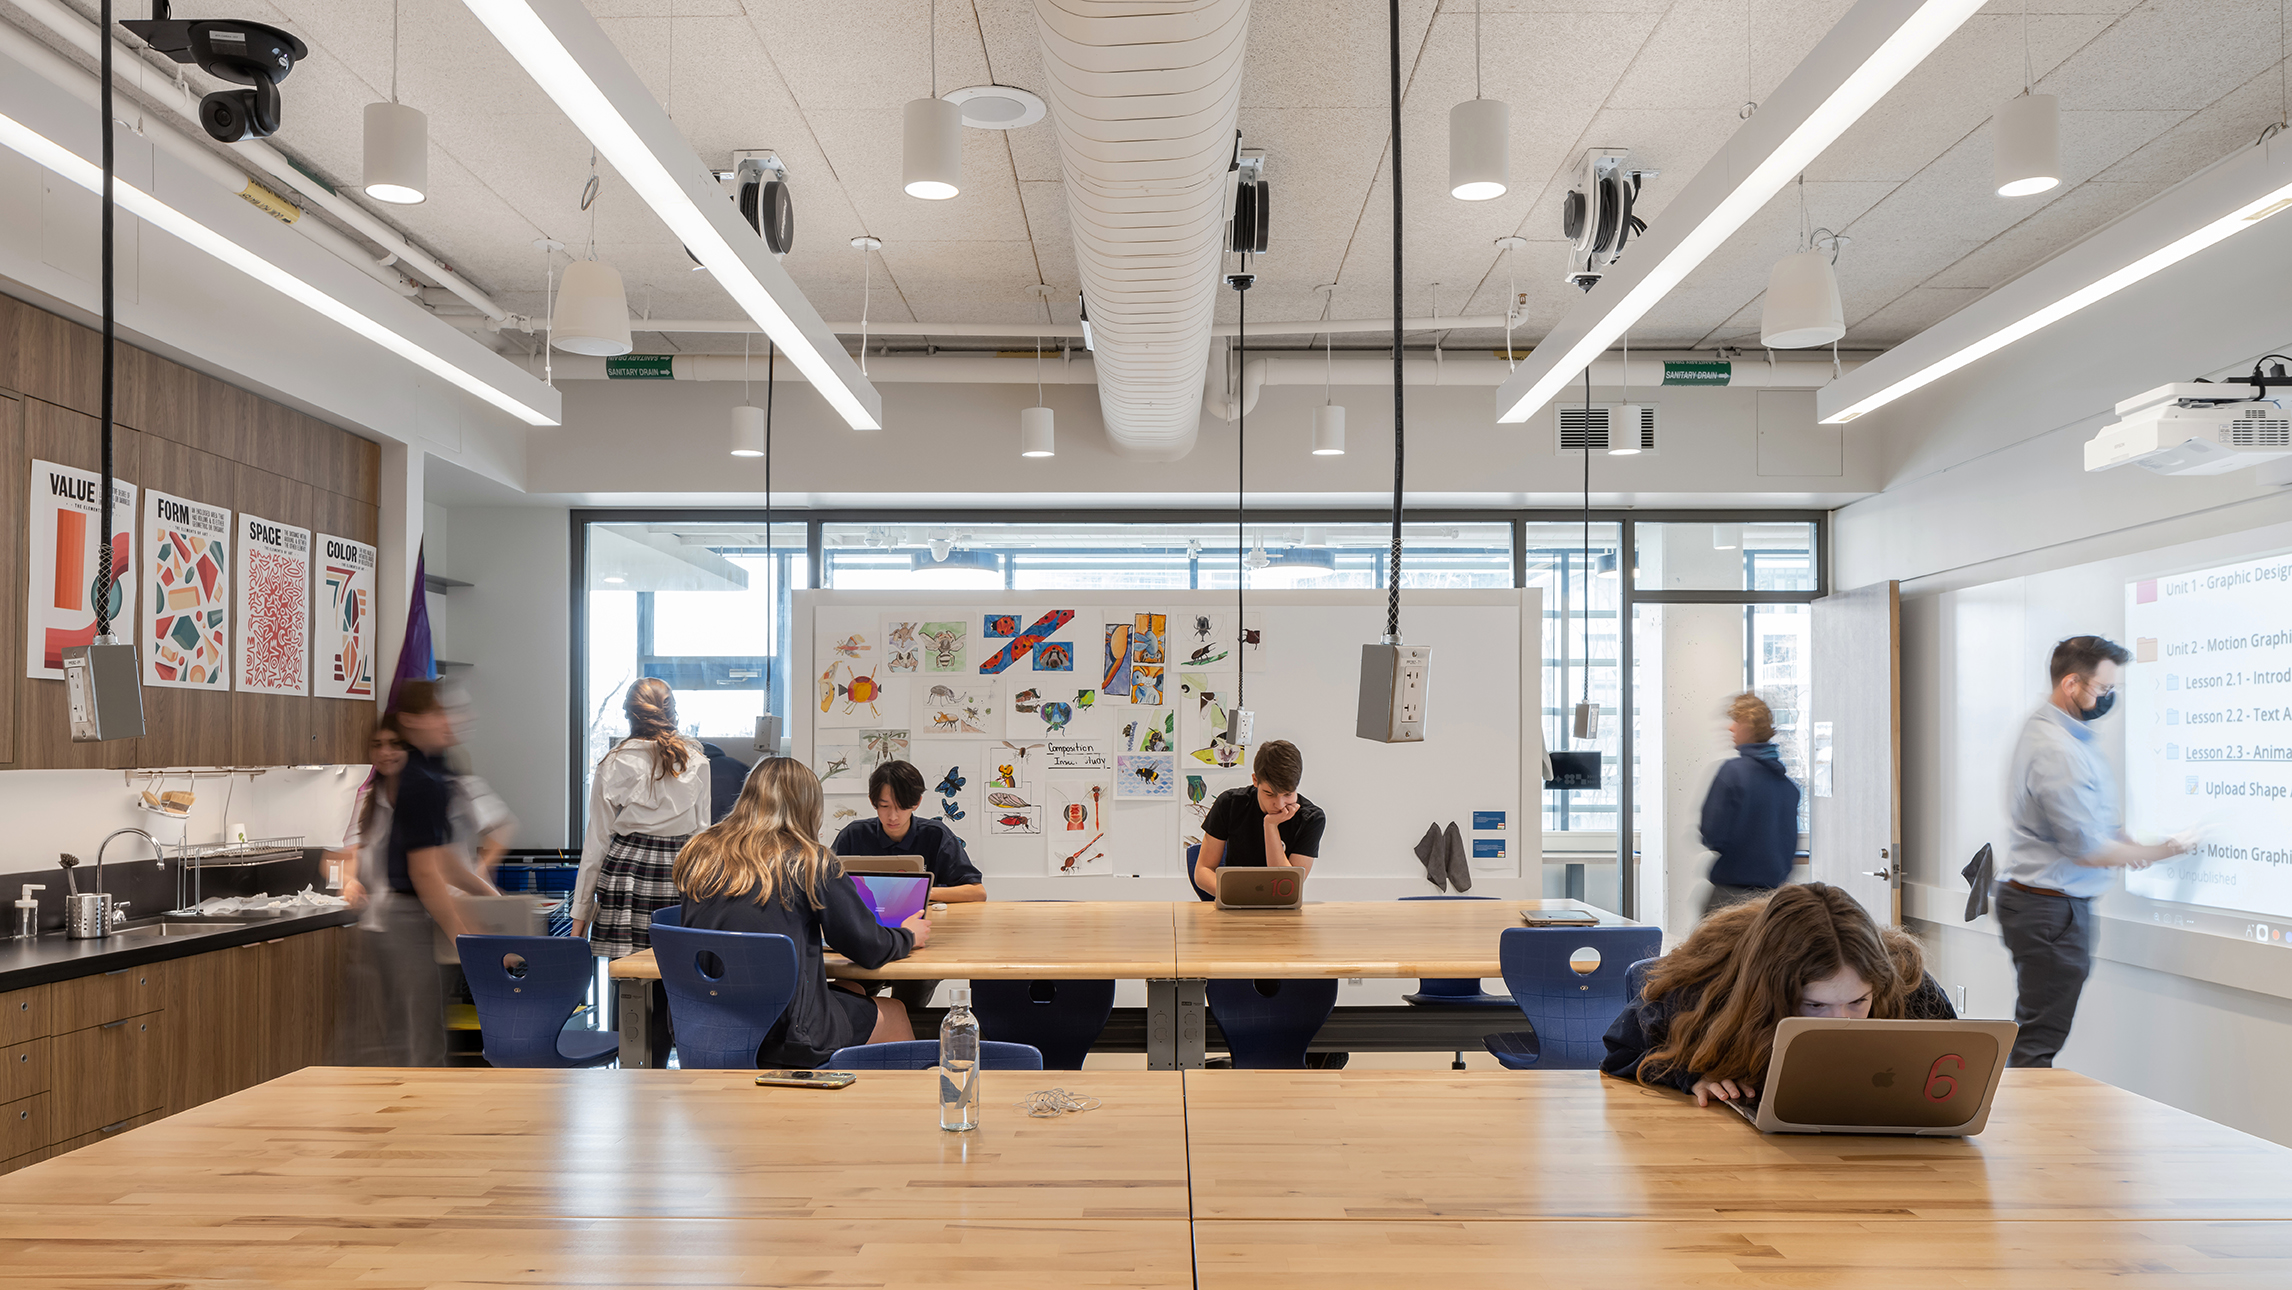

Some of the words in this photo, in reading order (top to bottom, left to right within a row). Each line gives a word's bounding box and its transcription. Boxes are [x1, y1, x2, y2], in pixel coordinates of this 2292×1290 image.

[607, 368, 638, 376] SANITARY
[640, 368, 659, 376] DRAIN
[1665, 370, 1697, 379] SANITARY
[1697, 371, 1717, 379] DRAIN
[49, 472, 96, 503] VALUE
[158, 497, 190, 526] FORM
[249, 521, 282, 547] SPACE
[326, 540, 358, 563] COLOR
[2166, 580, 2189, 596] Unit
[2191, 579, 2197, 592] 1
[2207, 569, 2251, 590] Graphic
[2166, 642, 2189, 657] Unit
[2191, 641, 2197, 654] 2
[2207, 636, 2247, 652] Motion
[2250, 629, 2292, 649] Graphi
[2186, 676, 2223, 690] Lesson
[2226, 672, 2242, 686] 2.1
[2253, 667, 2291, 685] Introd
[2186, 711, 2223, 725] Lesson
[2226, 708, 2243, 723] 2.2
[2253, 707, 2280, 722] Text
[2283, 707, 2292, 721] A
[1048, 742, 1094, 757] Composition
[2186, 746, 2223, 760] Lesson
[2226, 745, 2243, 759] 2.3
[2253, 744, 2292, 759] Anima
[1054, 757, 1078, 766] Inse
[2206, 781, 2246, 799] Upload
[2249, 781, 2287, 801] Shape
[2191, 842, 2198, 856] 3
[2207, 843, 2248, 860] Motion
[2251, 847, 2292, 867] Graphi
[1270, 878, 1295, 897] 10
[2178, 868, 2237, 886] Unpublished
[1922, 1053, 1966, 1103] 6
